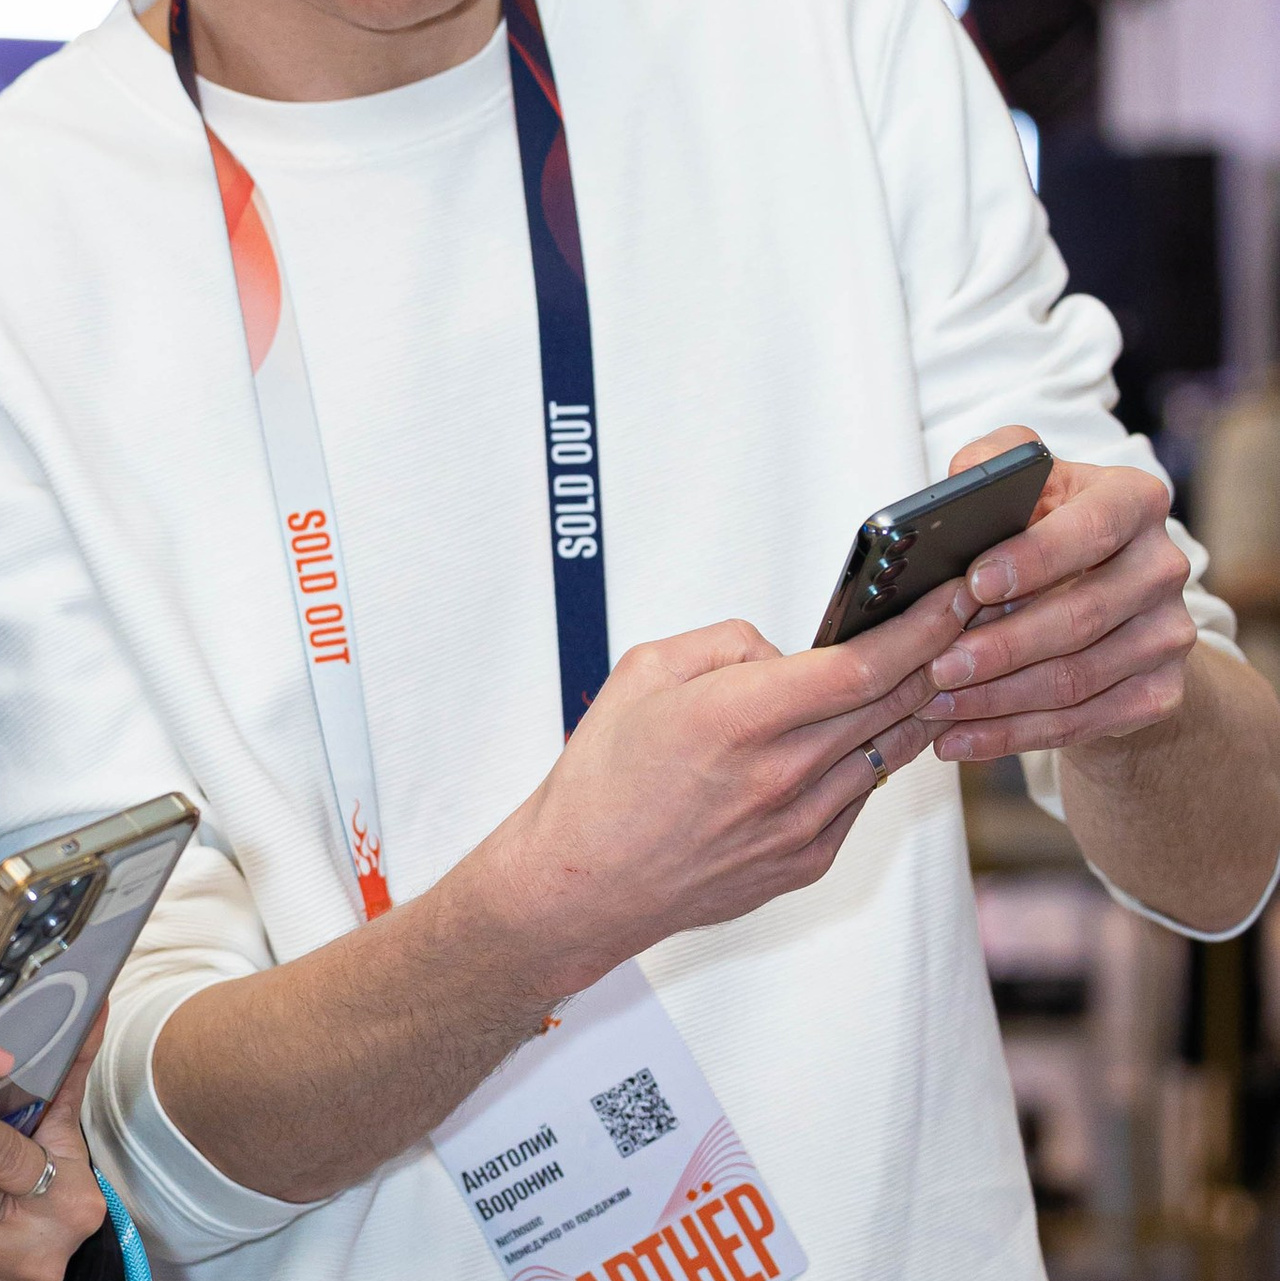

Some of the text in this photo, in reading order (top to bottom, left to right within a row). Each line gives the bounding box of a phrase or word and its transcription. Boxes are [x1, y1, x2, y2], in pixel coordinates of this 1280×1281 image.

[549, 400, 598, 559] SOLD OUT
[287, 509, 351, 664] SOLD OUT
[461, 1123, 558, 1194] Анатолий
[475, 1161, 565, 1222] Воронин
